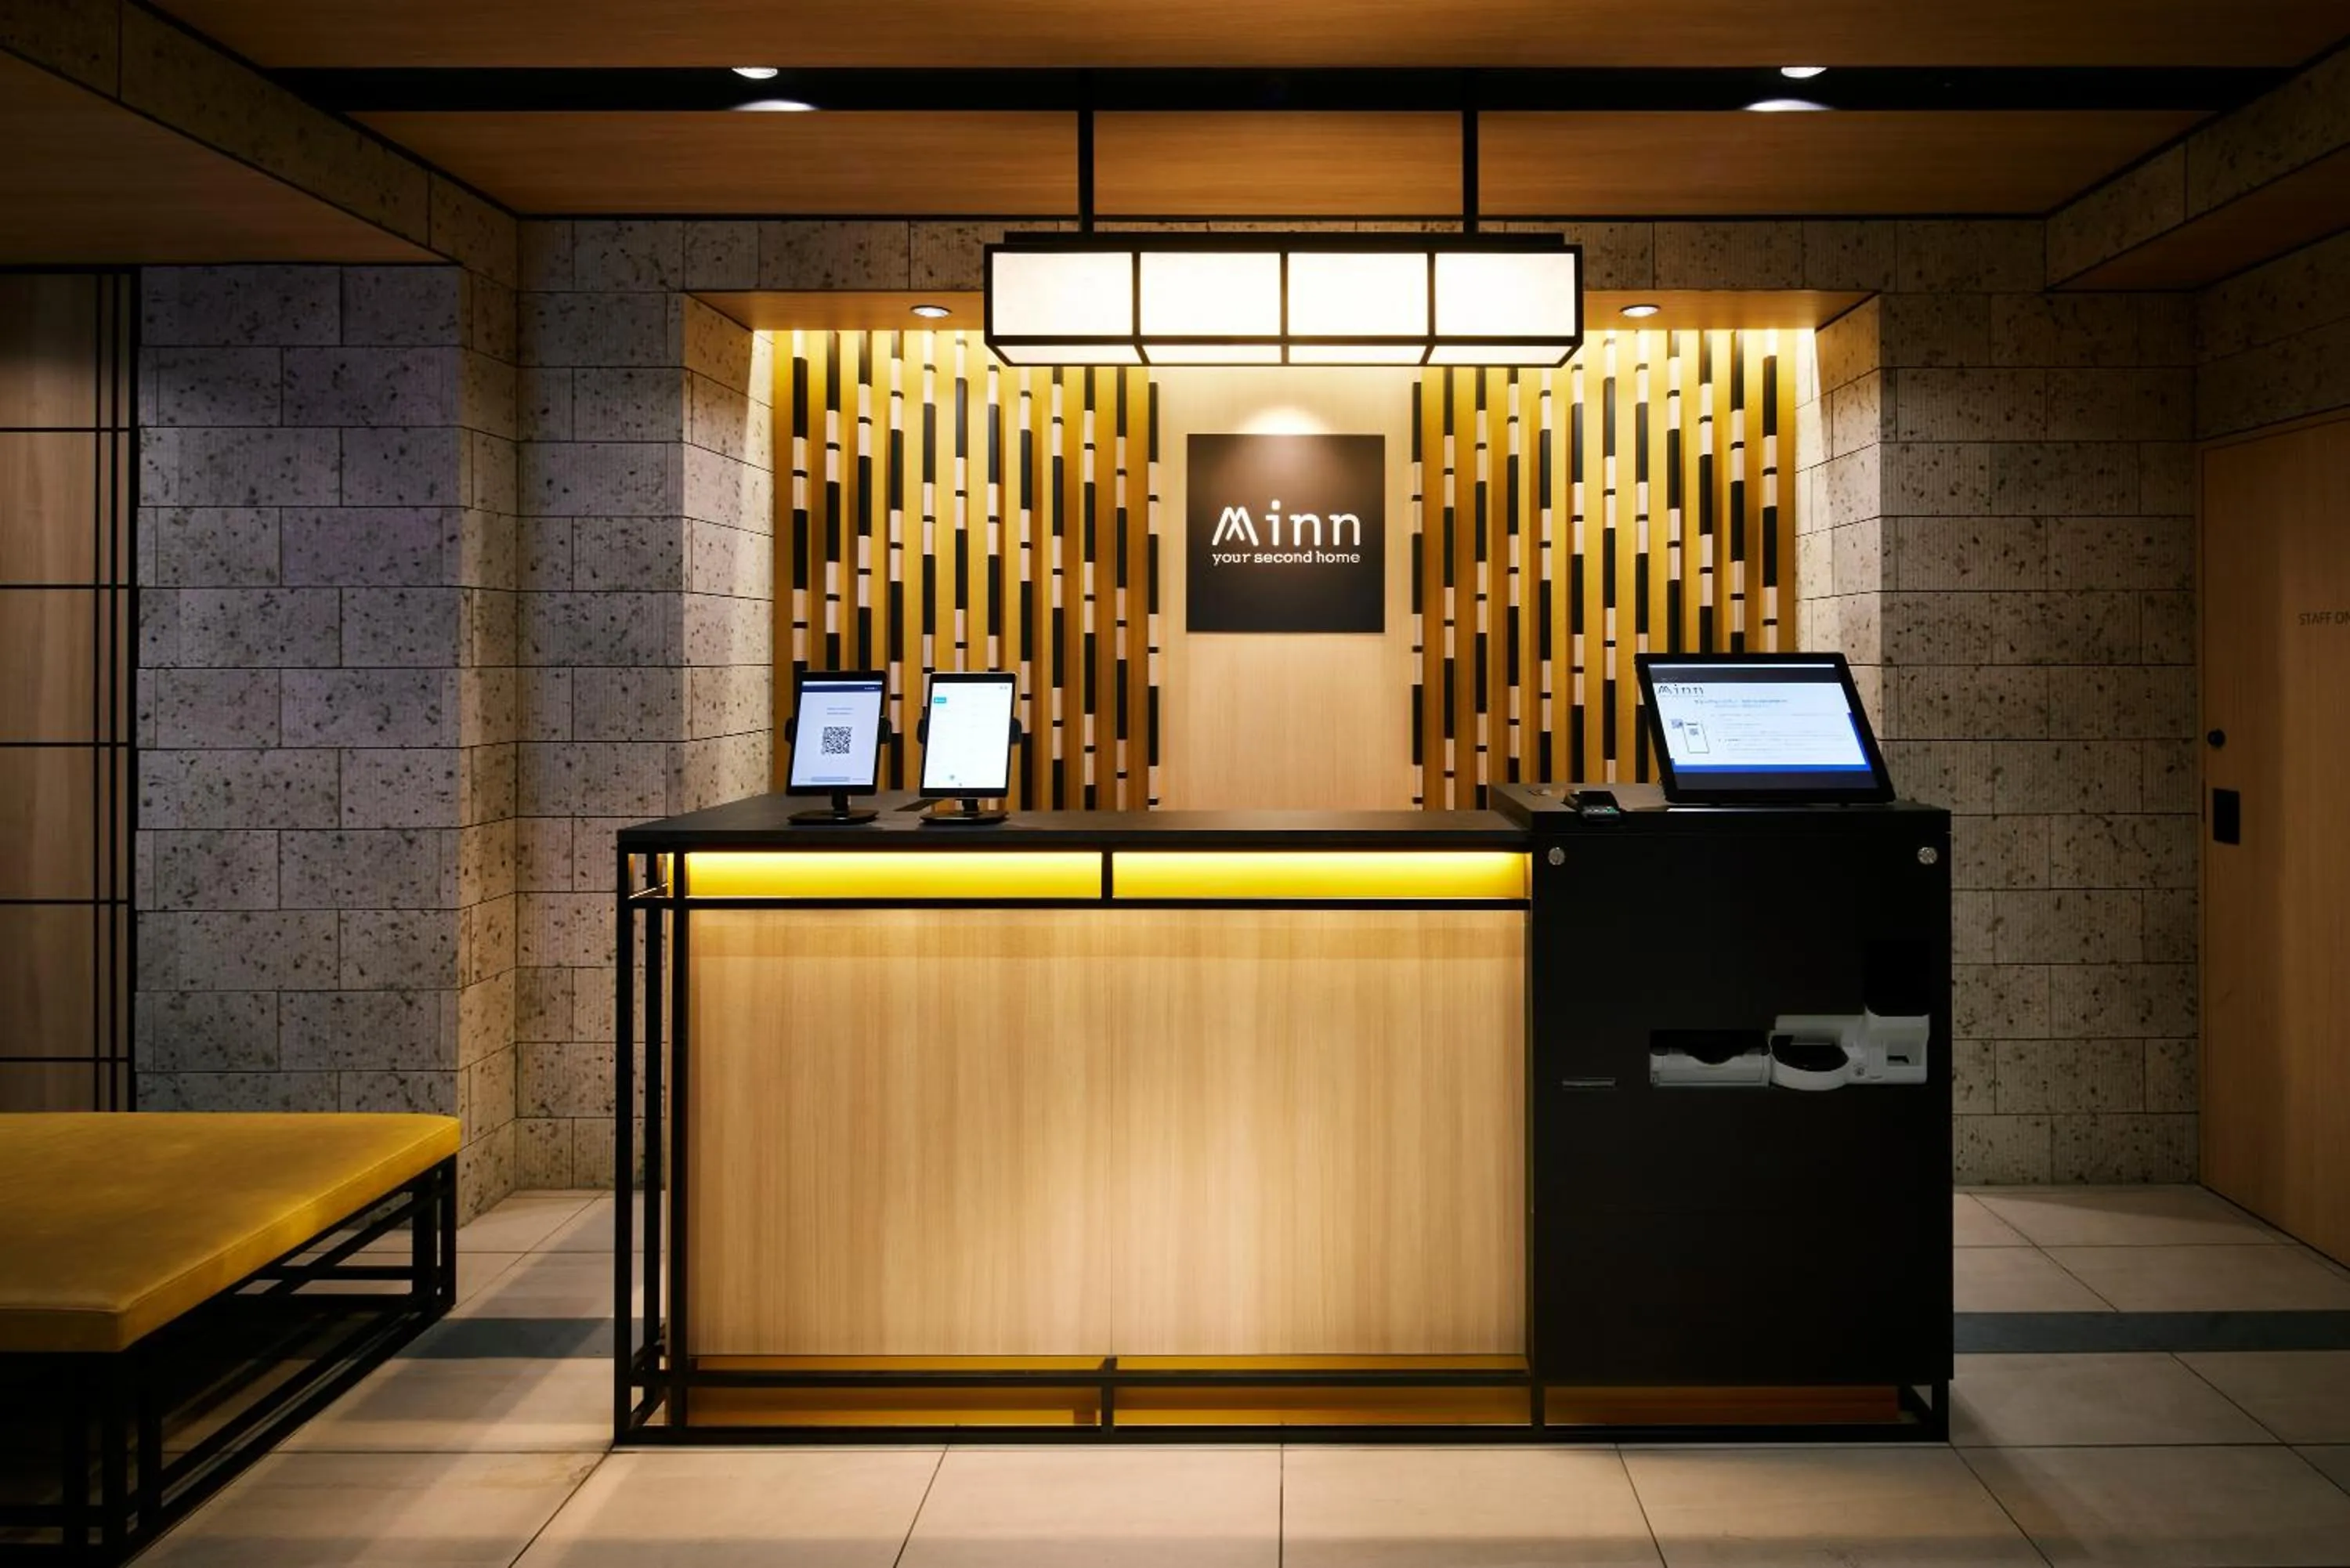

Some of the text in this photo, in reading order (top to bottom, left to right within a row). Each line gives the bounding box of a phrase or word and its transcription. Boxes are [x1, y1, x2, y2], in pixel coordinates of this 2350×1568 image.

[1212, 499, 1361, 546] Minn
[1212, 551, 1361, 566] your second home
[2298, 612, 2332, 626] STAFF
